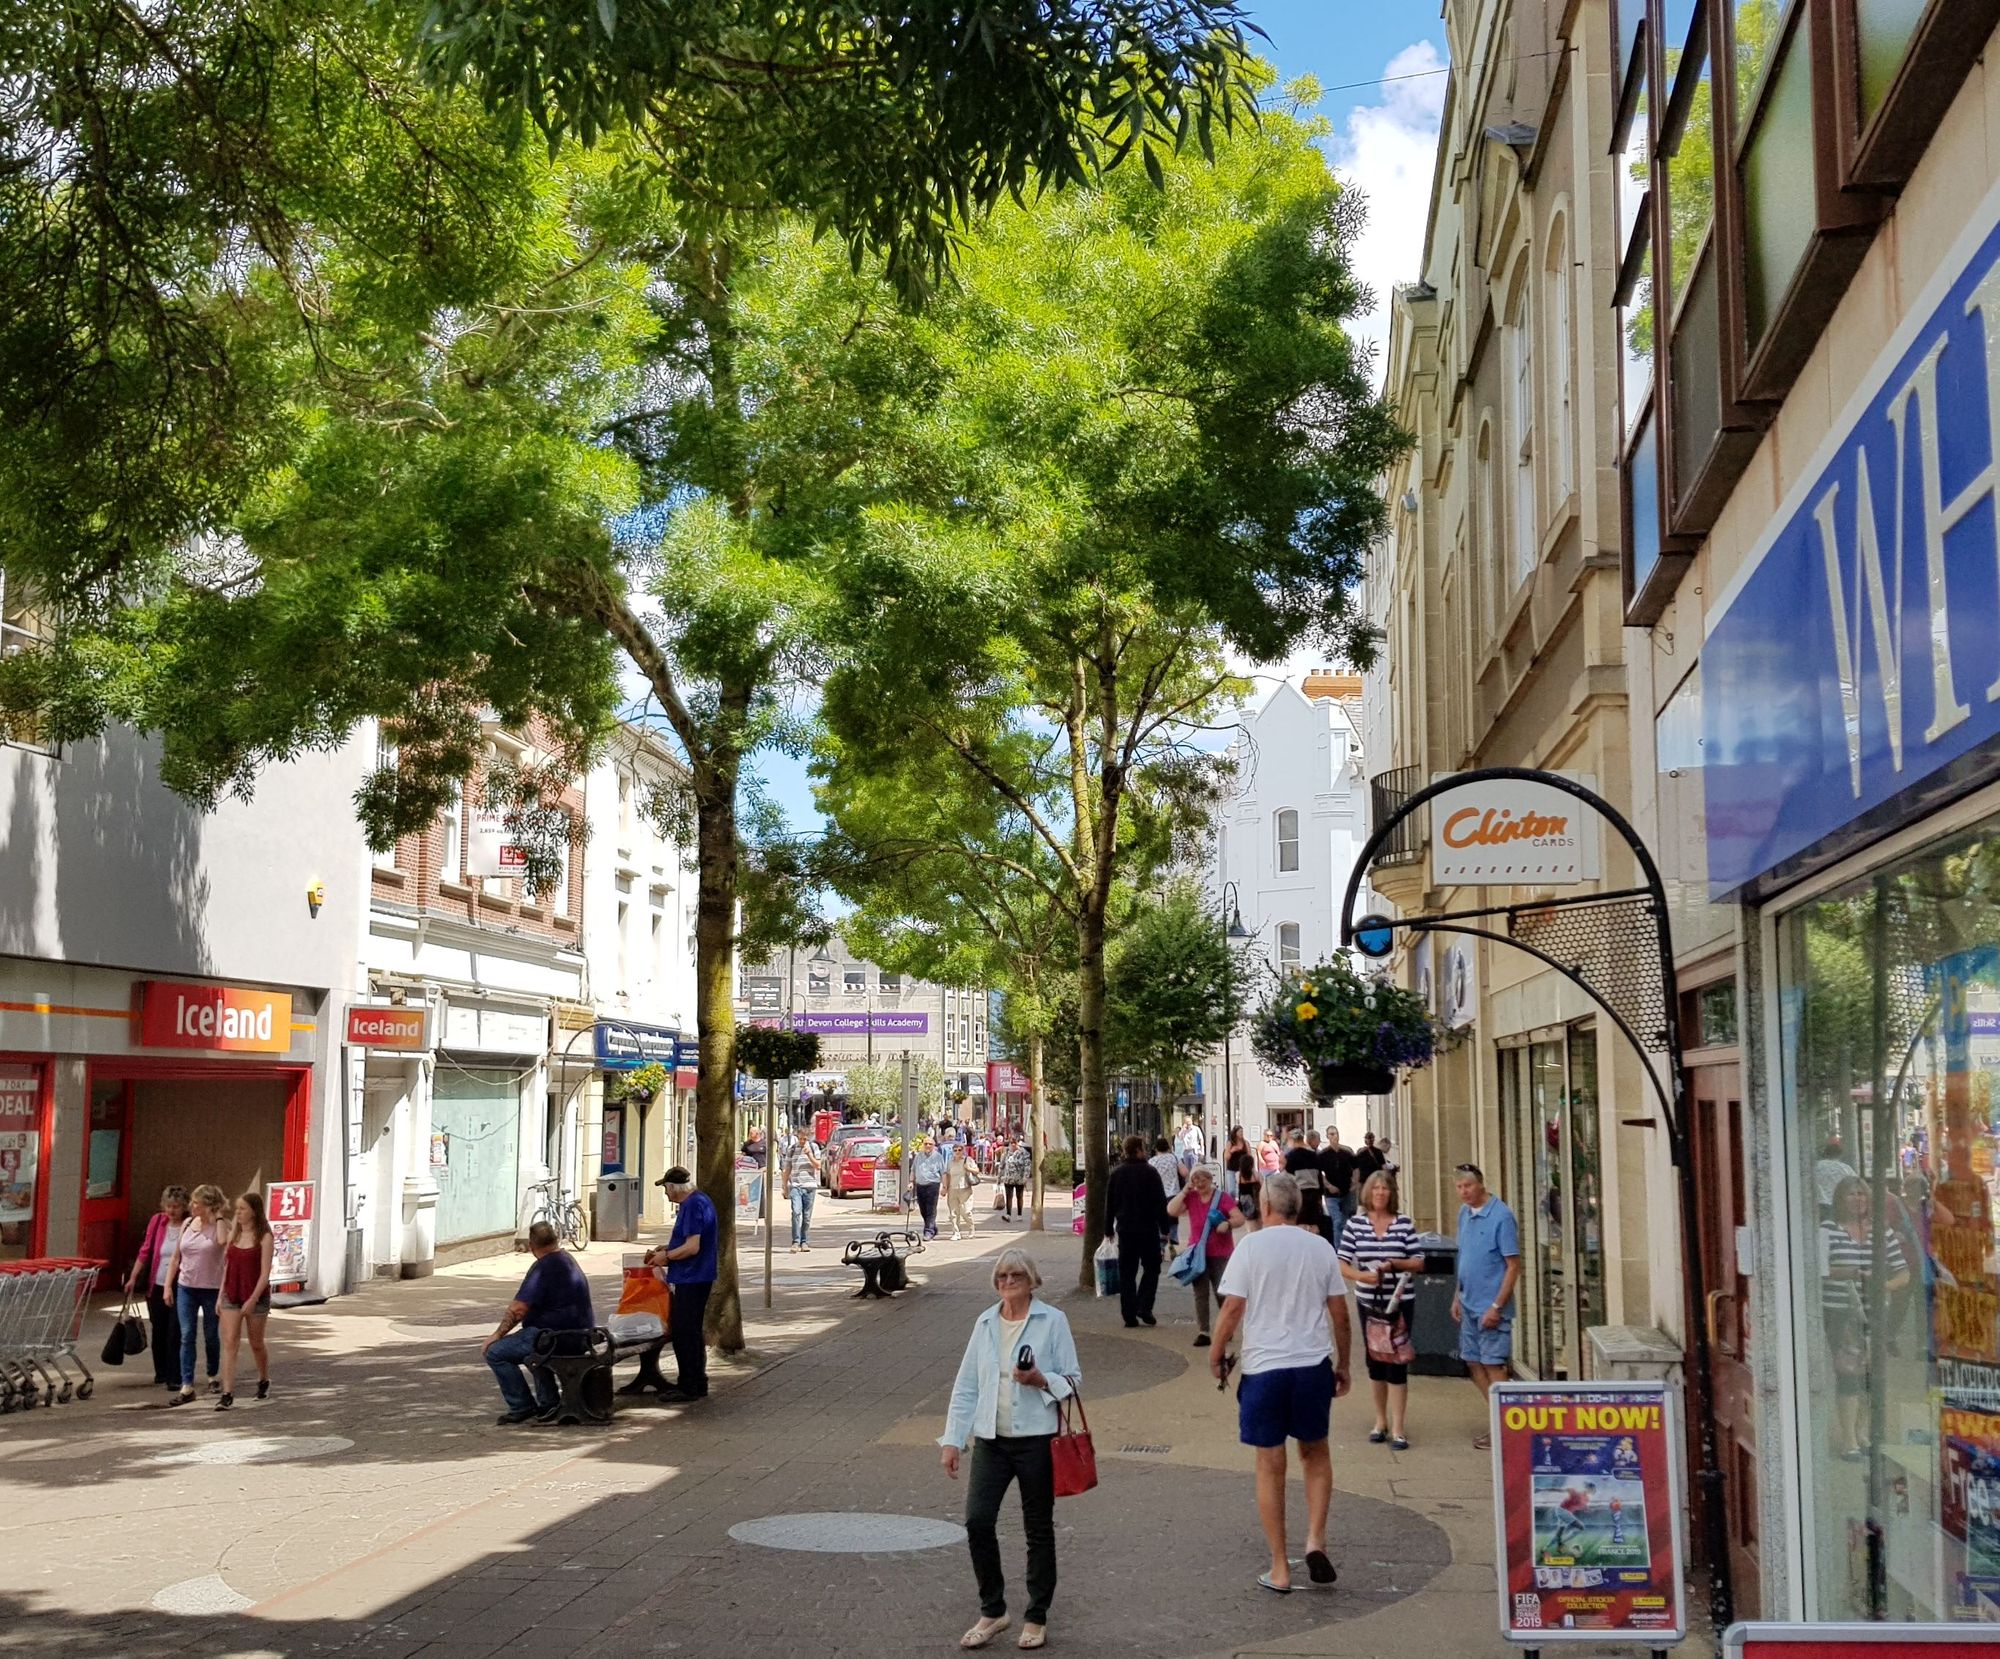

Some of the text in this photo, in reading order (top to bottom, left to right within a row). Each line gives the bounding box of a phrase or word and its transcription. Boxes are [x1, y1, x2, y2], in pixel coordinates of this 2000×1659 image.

[477, 814, 500, 823] PRIME
[1443, 807, 1568, 848] Clinton
[1532, 838, 1574, 847] CARDS
[176, 995, 272, 1040] Iceland
[808, 1018, 833, 1027] Devon
[834, 1018, 864, 1029] College
[887, 1018, 923, 1029] Academy
[353, 1018, 419, 1037] Iceland
[280, 1186, 306, 1217] £1
[1505, 1406, 1660, 1431] OUT NOW!
[1515, 1593, 1540, 1604] FIFA
[1516, 1618, 1542, 1628] 2019
